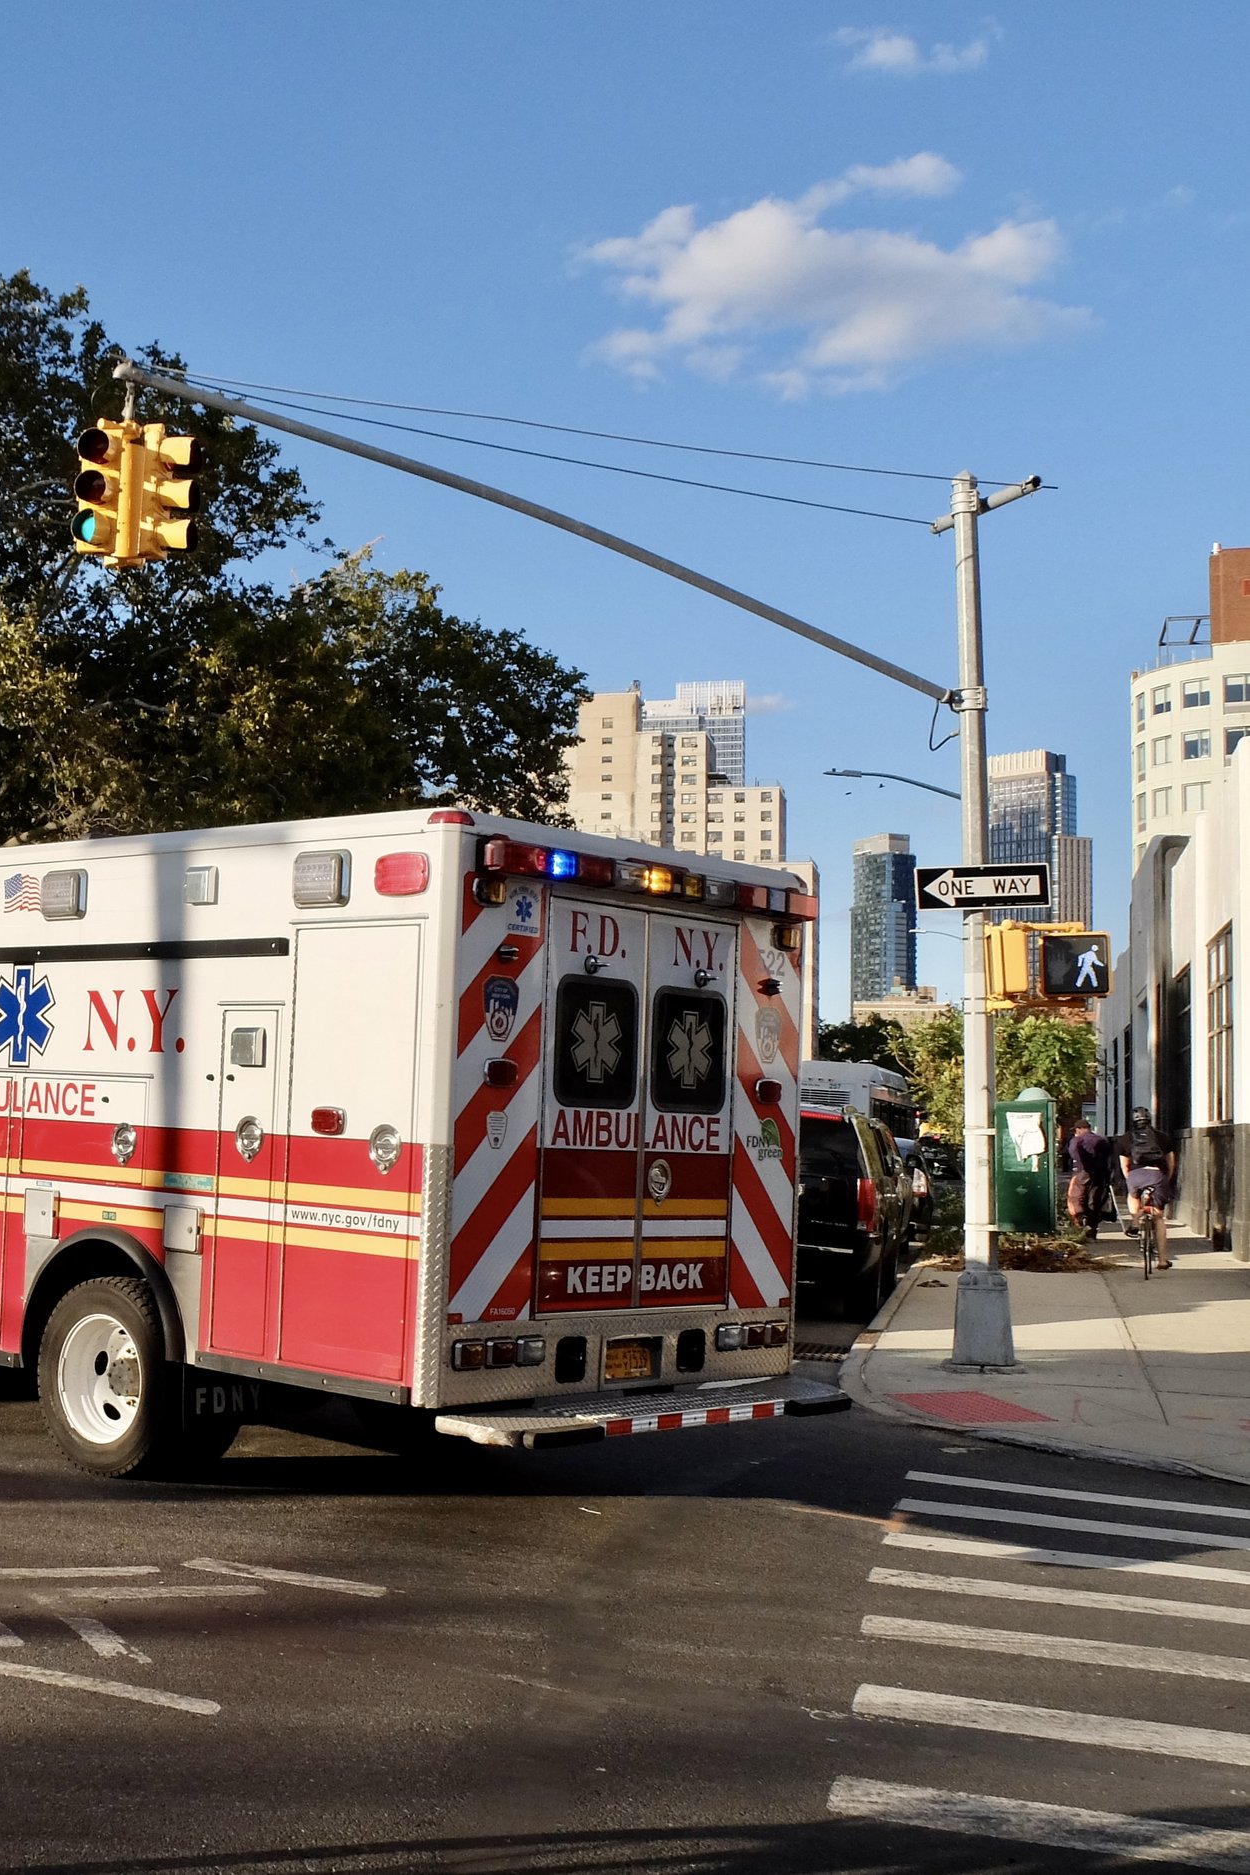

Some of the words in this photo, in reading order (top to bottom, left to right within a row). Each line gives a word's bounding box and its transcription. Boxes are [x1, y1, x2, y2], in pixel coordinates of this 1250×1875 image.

[938, 879, 975, 896] ONE
[993, 877, 1031, 894] WAY
[570, 911, 626, 958] F.D.
[673, 927, 723, 971] N.Y.
[82, 989, 186, 1053] N.Y.
[551, 1108, 721, 1151] AMBULANCE
[746, 1135, 770, 1148] FDNY
[758, 1147, 783, 1161] green
[291, 1209, 399, 1232] www.nyc.gov/fdny
[566, 1265, 632, 1293] KEEP
[640, 1263, 704, 1291] BACK
[196, 1383, 261, 1415] FDNY
